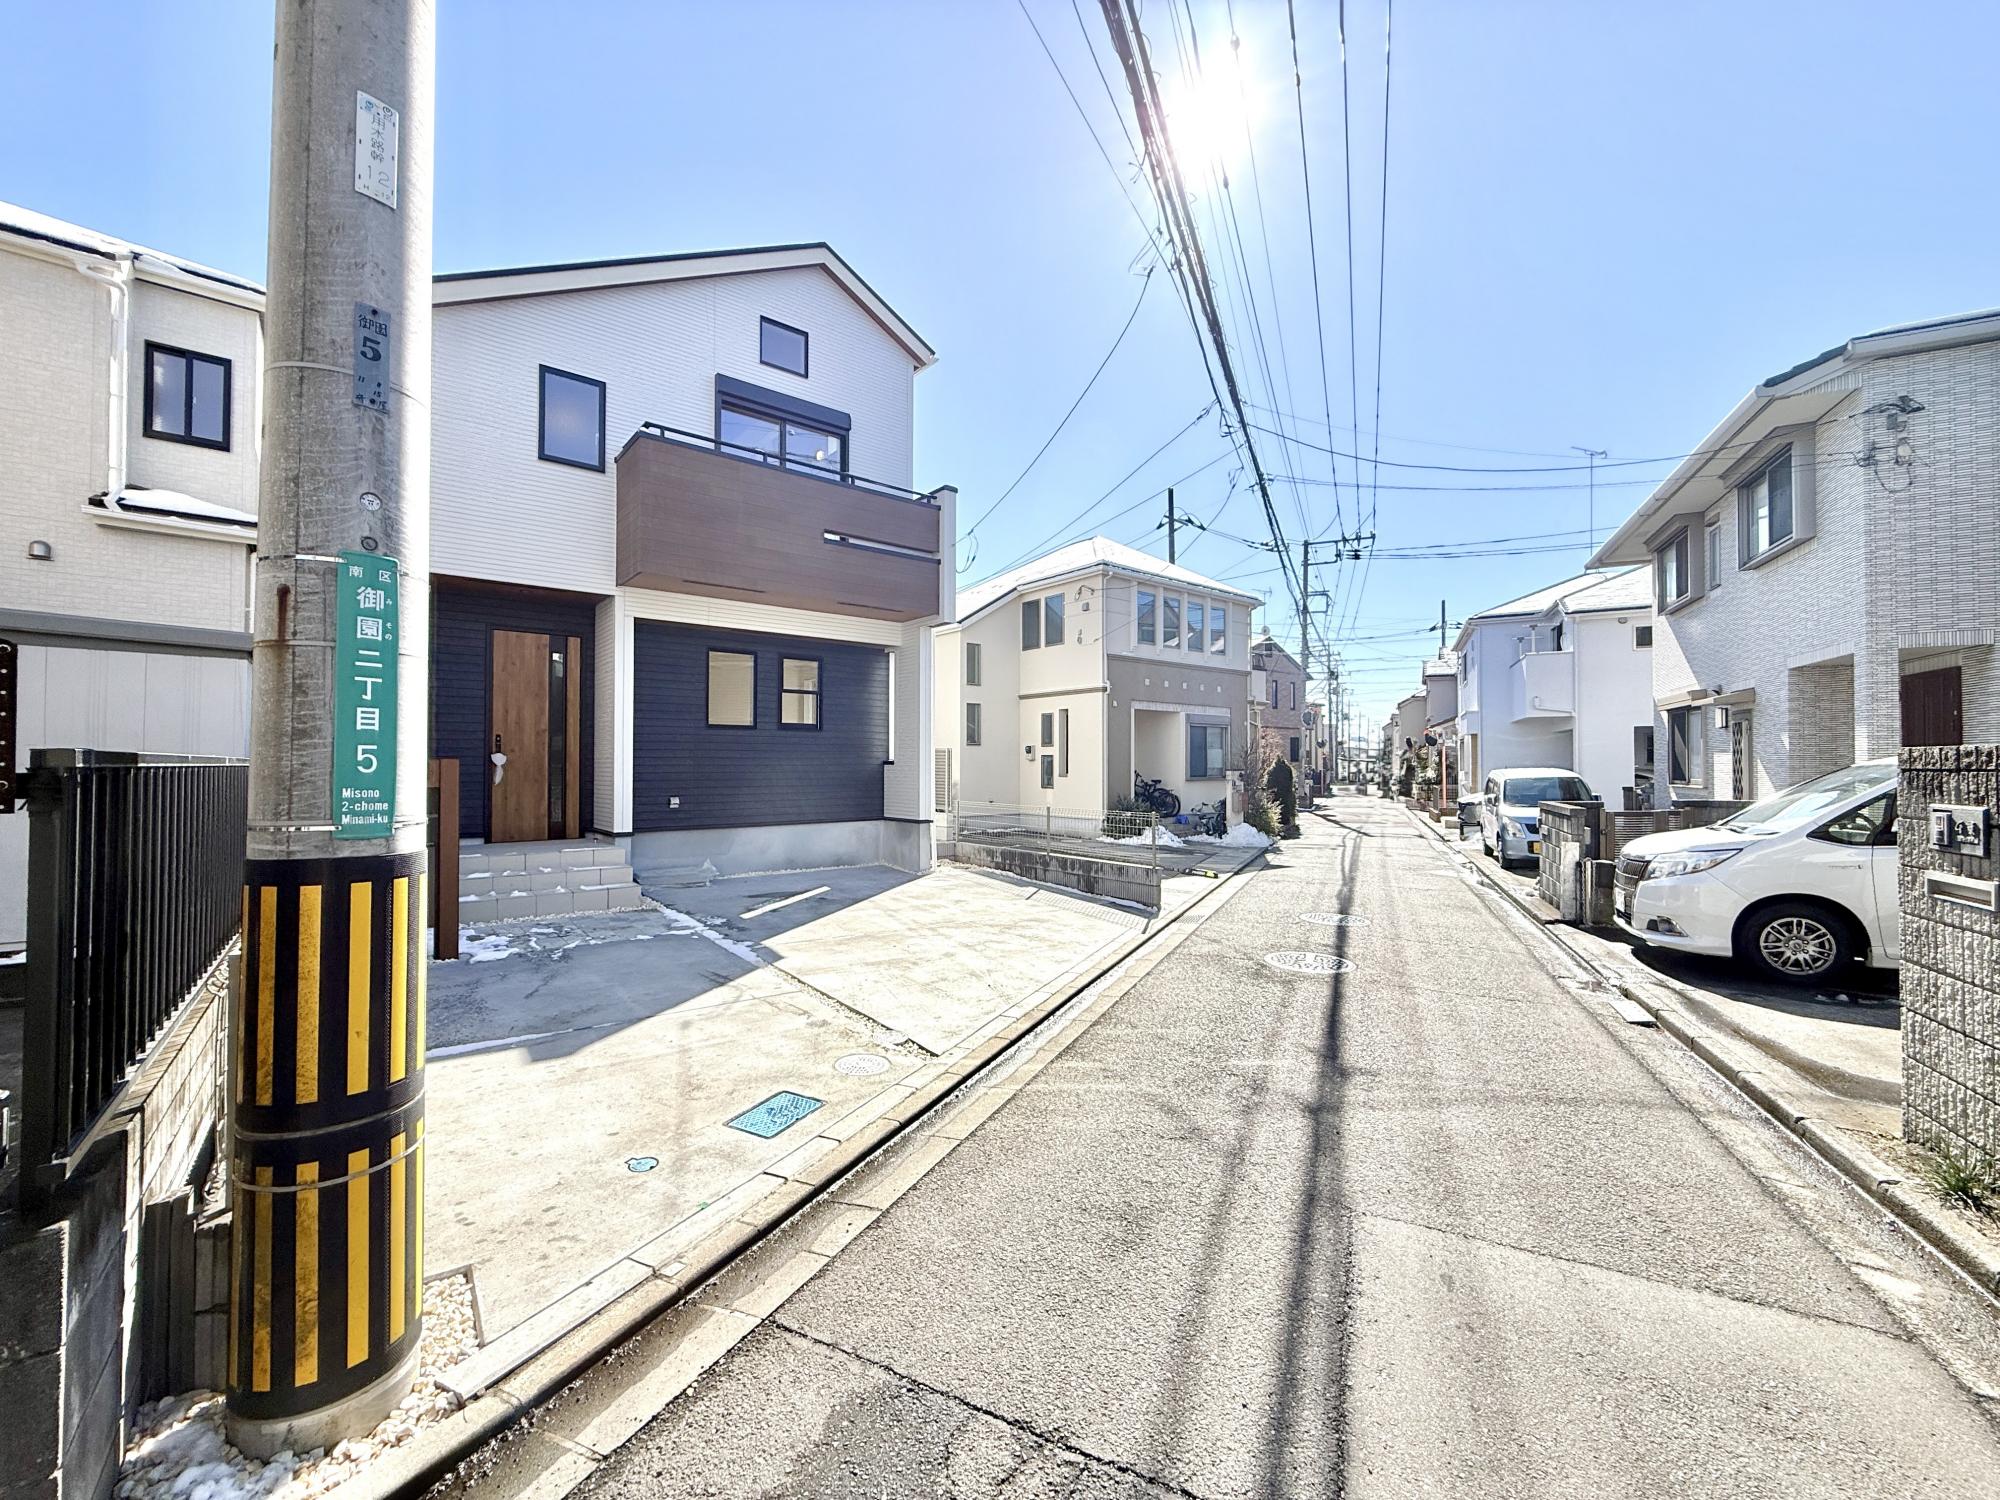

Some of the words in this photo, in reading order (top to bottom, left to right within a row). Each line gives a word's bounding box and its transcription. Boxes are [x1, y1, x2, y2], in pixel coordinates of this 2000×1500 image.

[359, 314, 388, 338] 御園
[360, 335, 382, 362] 5
[348, 565, 392, 583] 南区
[342, 787, 380, 799] Misono
[341, 800, 389, 812] 2-chome
[341, 813, 389, 825] Minami-ku
